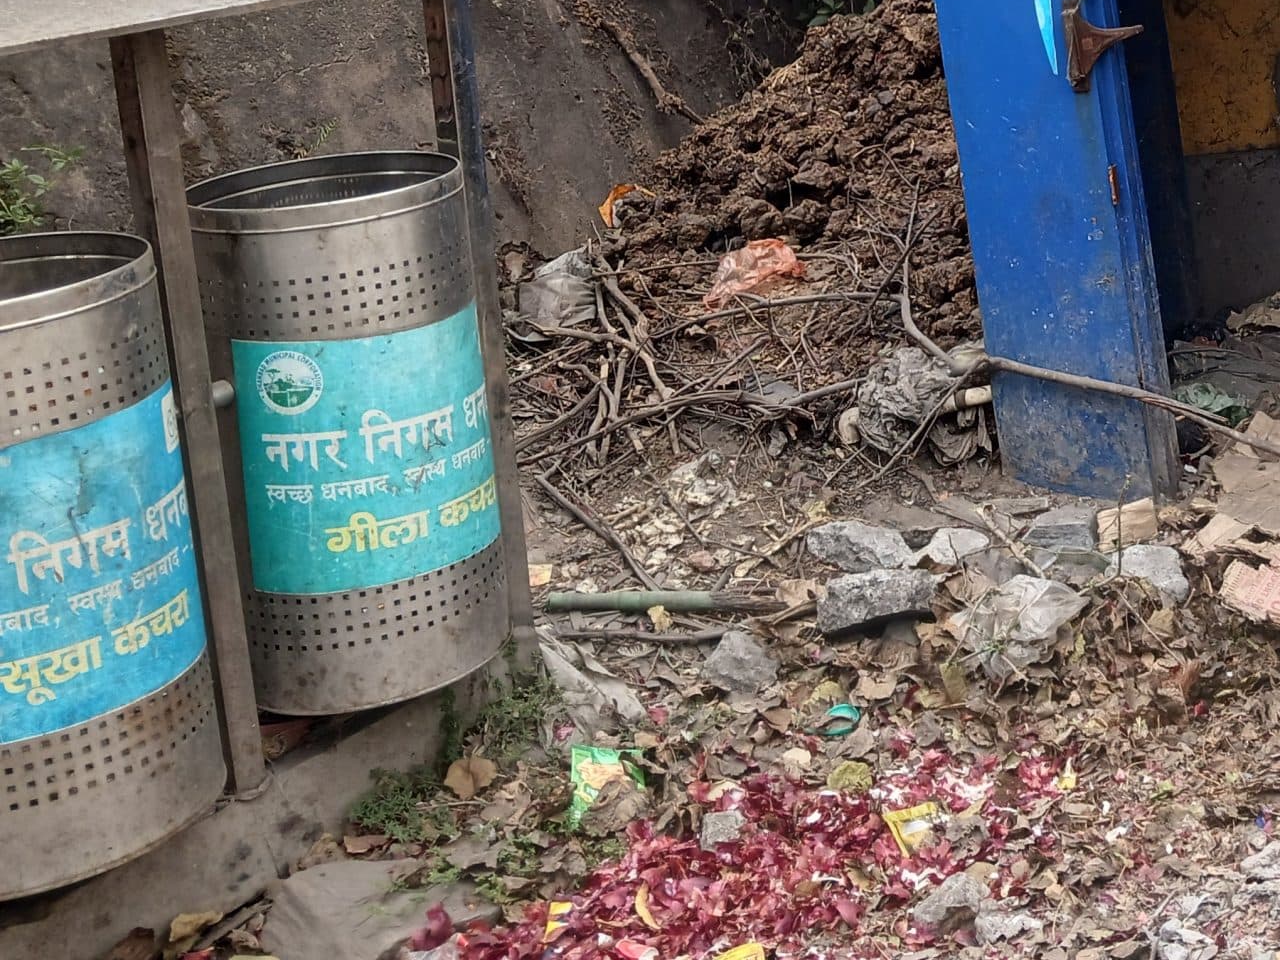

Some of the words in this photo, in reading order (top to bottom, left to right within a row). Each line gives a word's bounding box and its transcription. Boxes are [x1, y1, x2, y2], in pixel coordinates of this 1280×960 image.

[262, 430, 347, 472] नगर
[359, 405, 454, 465] निगम
[266, 484, 313, 504] स्वच्छ
[8, 518, 131, 595] निगम
[325, 510, 430, 552] गीला
[111, 589, 190, 656] कचरा
